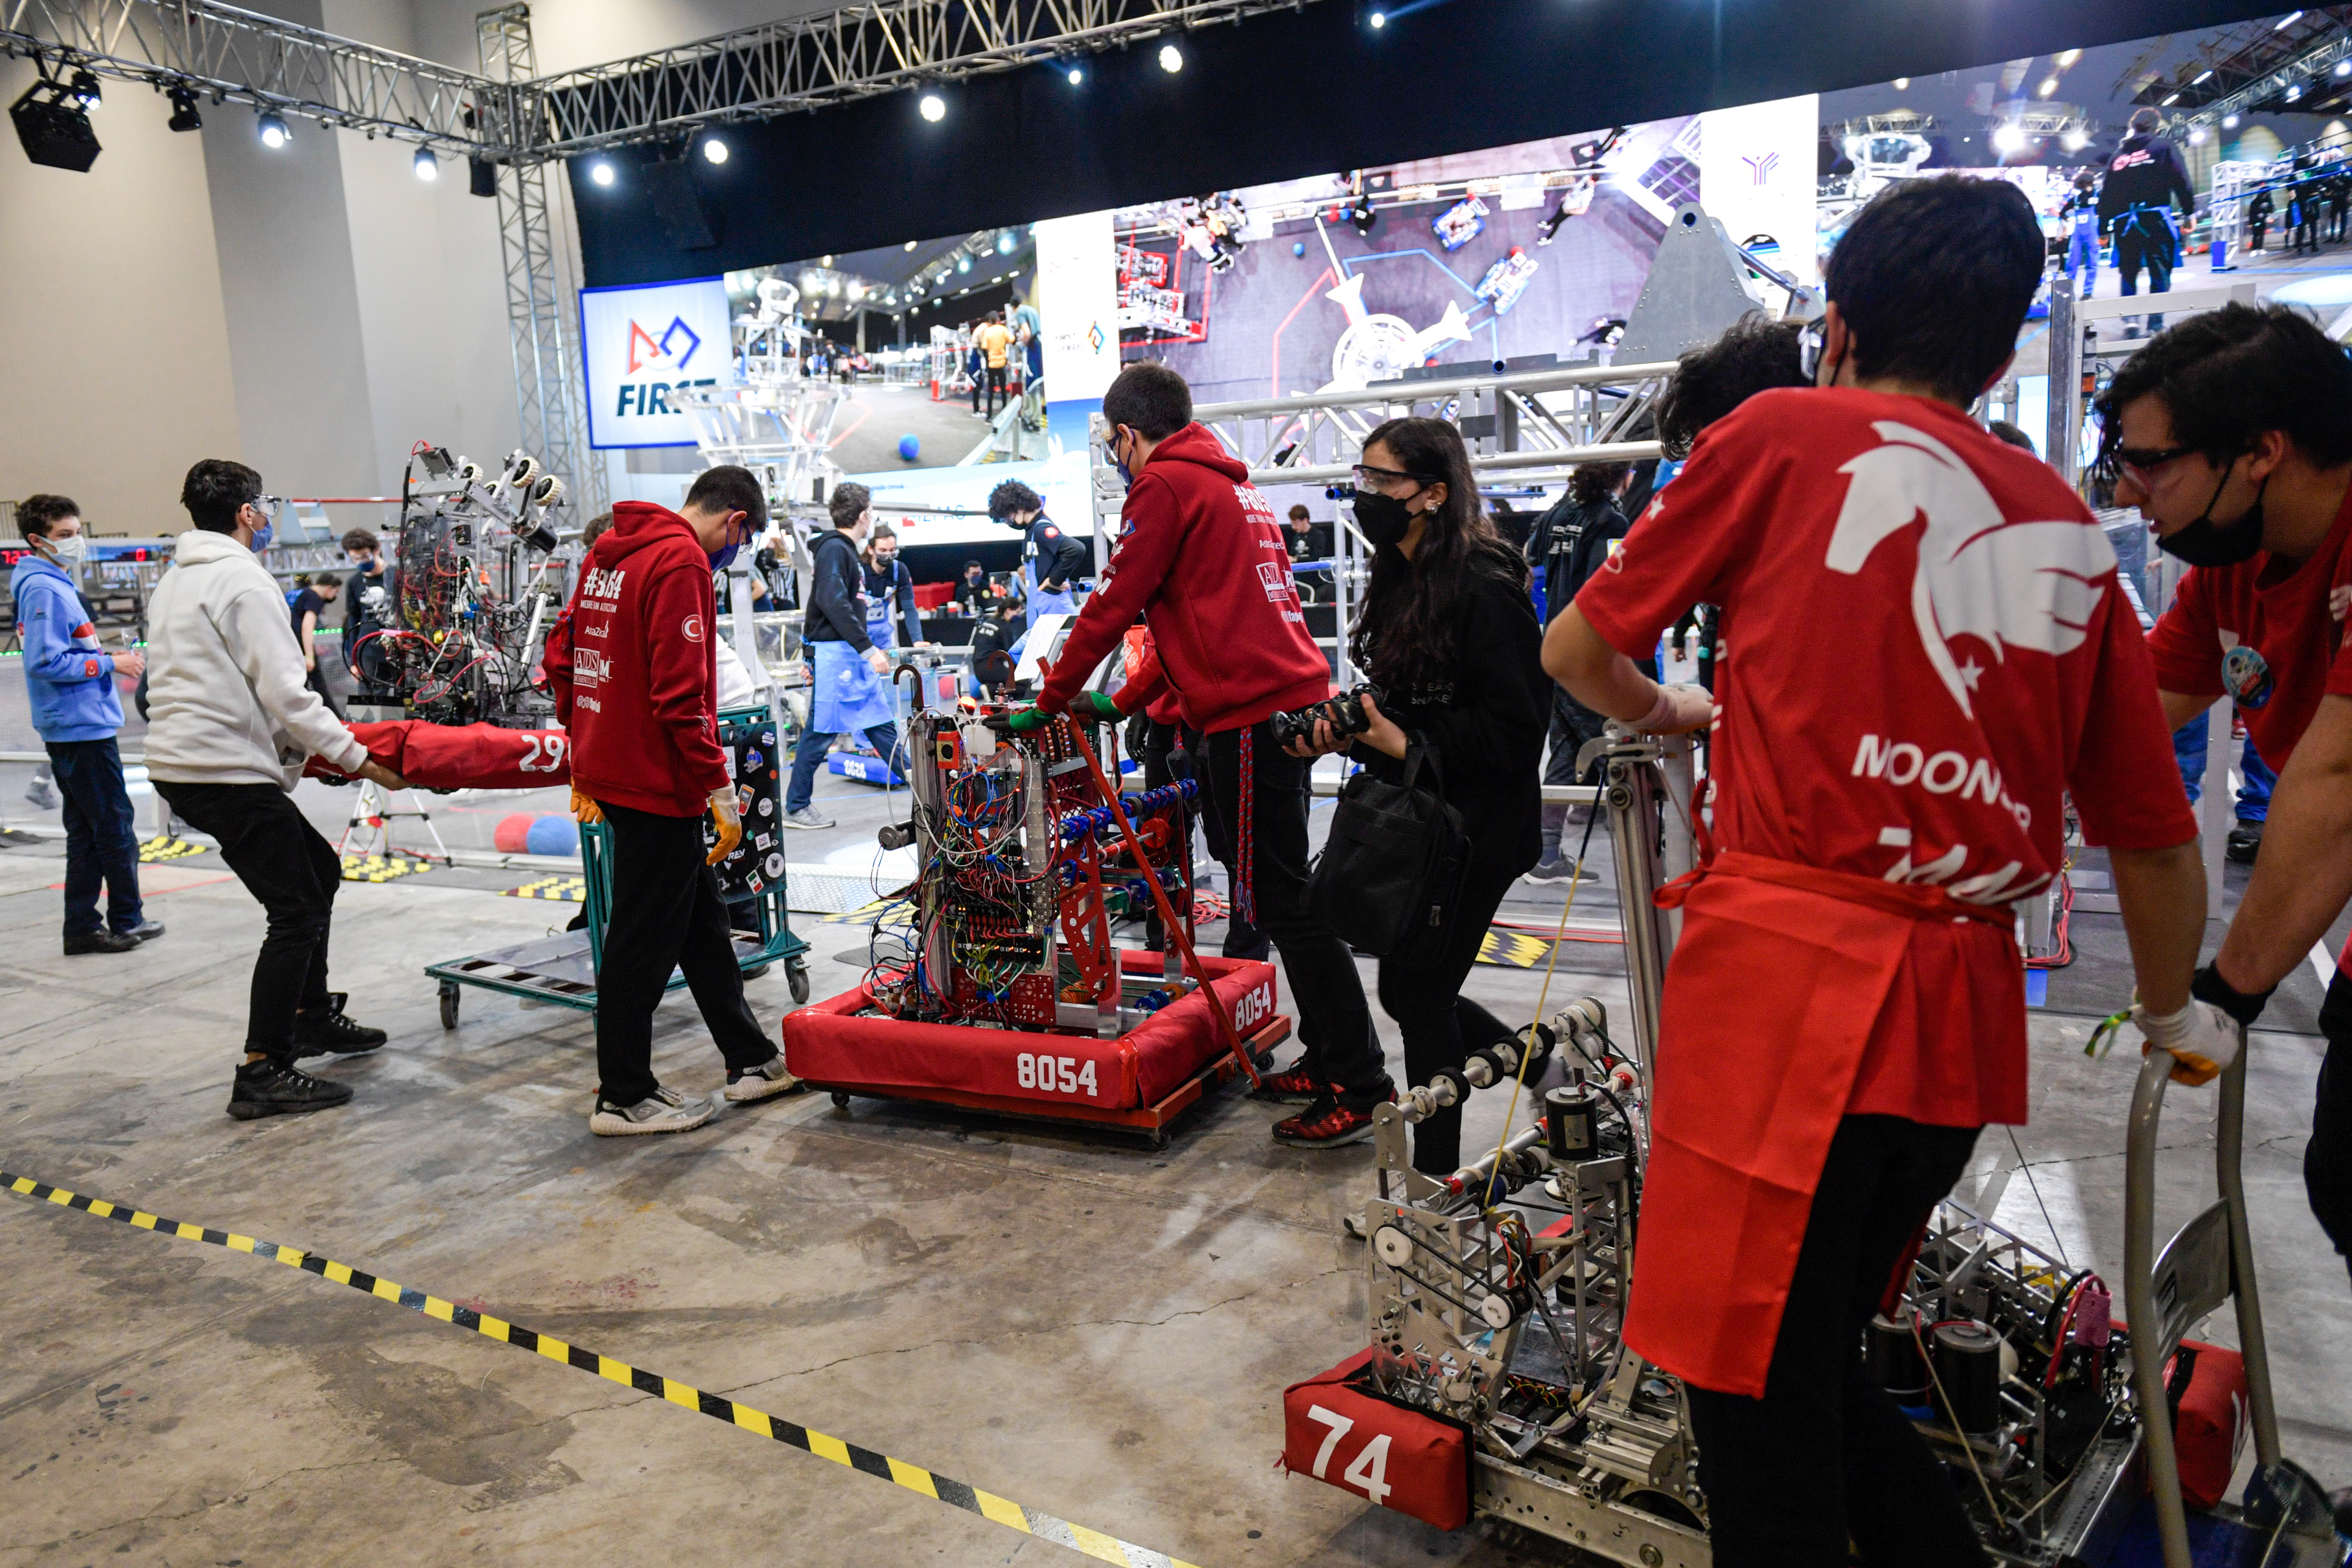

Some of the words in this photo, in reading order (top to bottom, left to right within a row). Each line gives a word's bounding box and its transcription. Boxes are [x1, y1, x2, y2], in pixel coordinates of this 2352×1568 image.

[1232, 485, 1272, 513] #805
[575, 651, 597, 671] ADS
[519, 734, 571, 773] 29
[727, 848, 746, 860] REV
[1234, 981, 1272, 1033] 8054
[1017, 1052, 1098, 1097] 8054
[1307, 1403, 1393, 1505] 74
